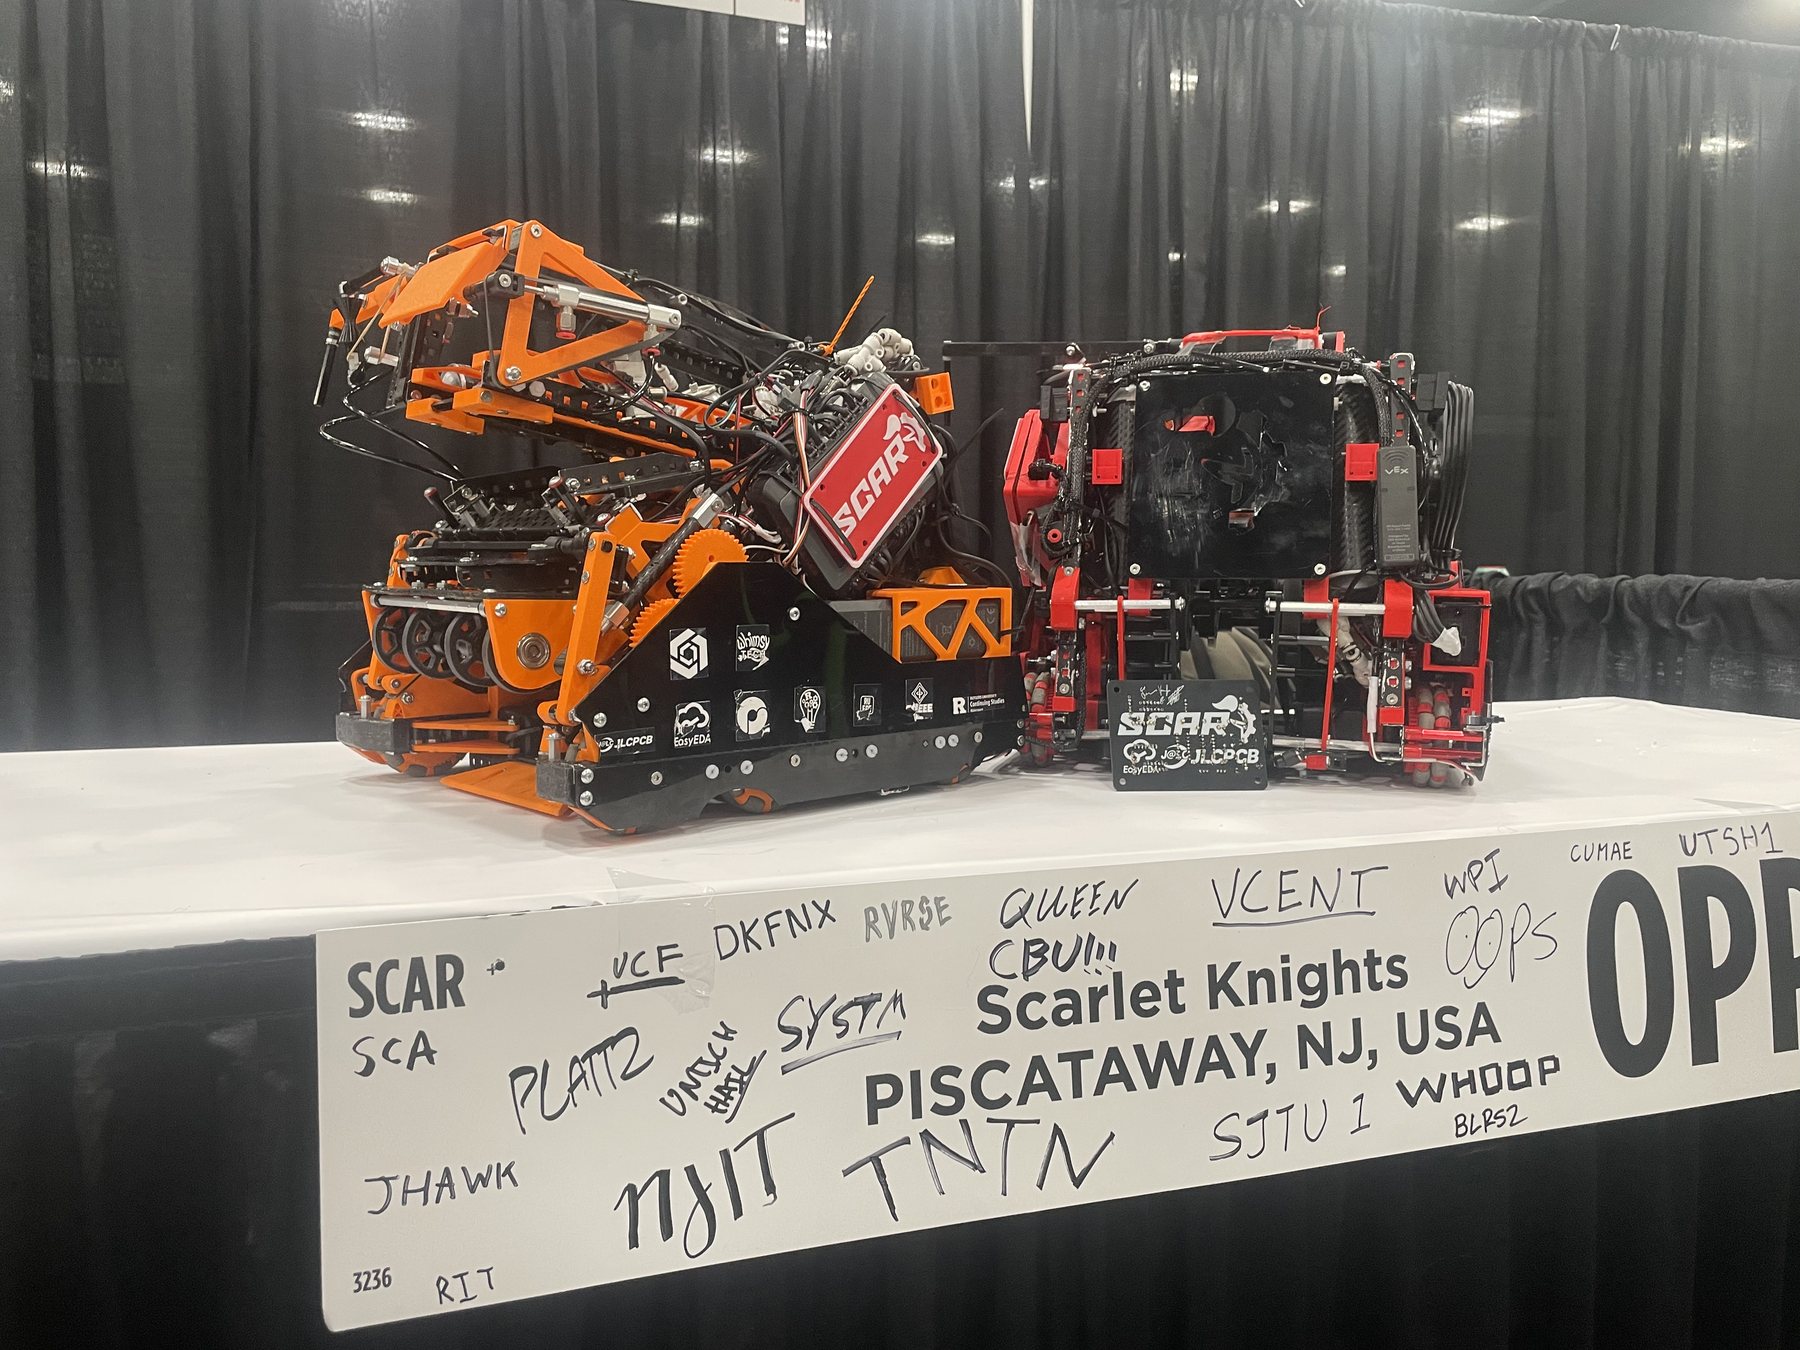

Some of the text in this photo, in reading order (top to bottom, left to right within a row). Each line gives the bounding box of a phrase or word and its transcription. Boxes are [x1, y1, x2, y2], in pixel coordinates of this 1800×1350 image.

[832, 433, 909, 542] SCAR
[1385, 466, 1409, 475] VEX
[952, 696, 967, 715] R
[1117, 711, 1230, 736] SCAR
[614, 735, 654, 750] JLCPCB
[674, 733, 711, 748] EasyEDA
[1190, 748, 1259, 765] JLCPCB
[1569, 841, 1633, 862] CUMAE
[1678, 821, 1784, 857] UTSH1
[1211, 866, 1389, 919] VCENT
[1443, 848, 1509, 899] WPI
[863, 896, 952, 943] RVRSE
[1000, 878, 1139, 930] QUEEN
[713, 899, 836, 961] DKFNX
[1446, 902, 1558, 989] OOPS
[347, 954, 466, 1018] SCAR
[976, 948, 1409, 1035] Scarlet Knights
[777, 988, 907, 1053] SYSTM
[352, 1030, 438, 1077] SCA
[866, 1001, 1502, 1126] PISCATAWAY, NJ, USA
[1395, 1054, 1561, 1109] WHOOP
[1209, 1098, 1328, 1162] SJTU
[364, 1160, 519, 1215] JHAWK
[842, 1117, 1116, 1222] TNTN
[353, 1266, 392, 1294] 3236
[436, 1266, 495, 1305] RIT
